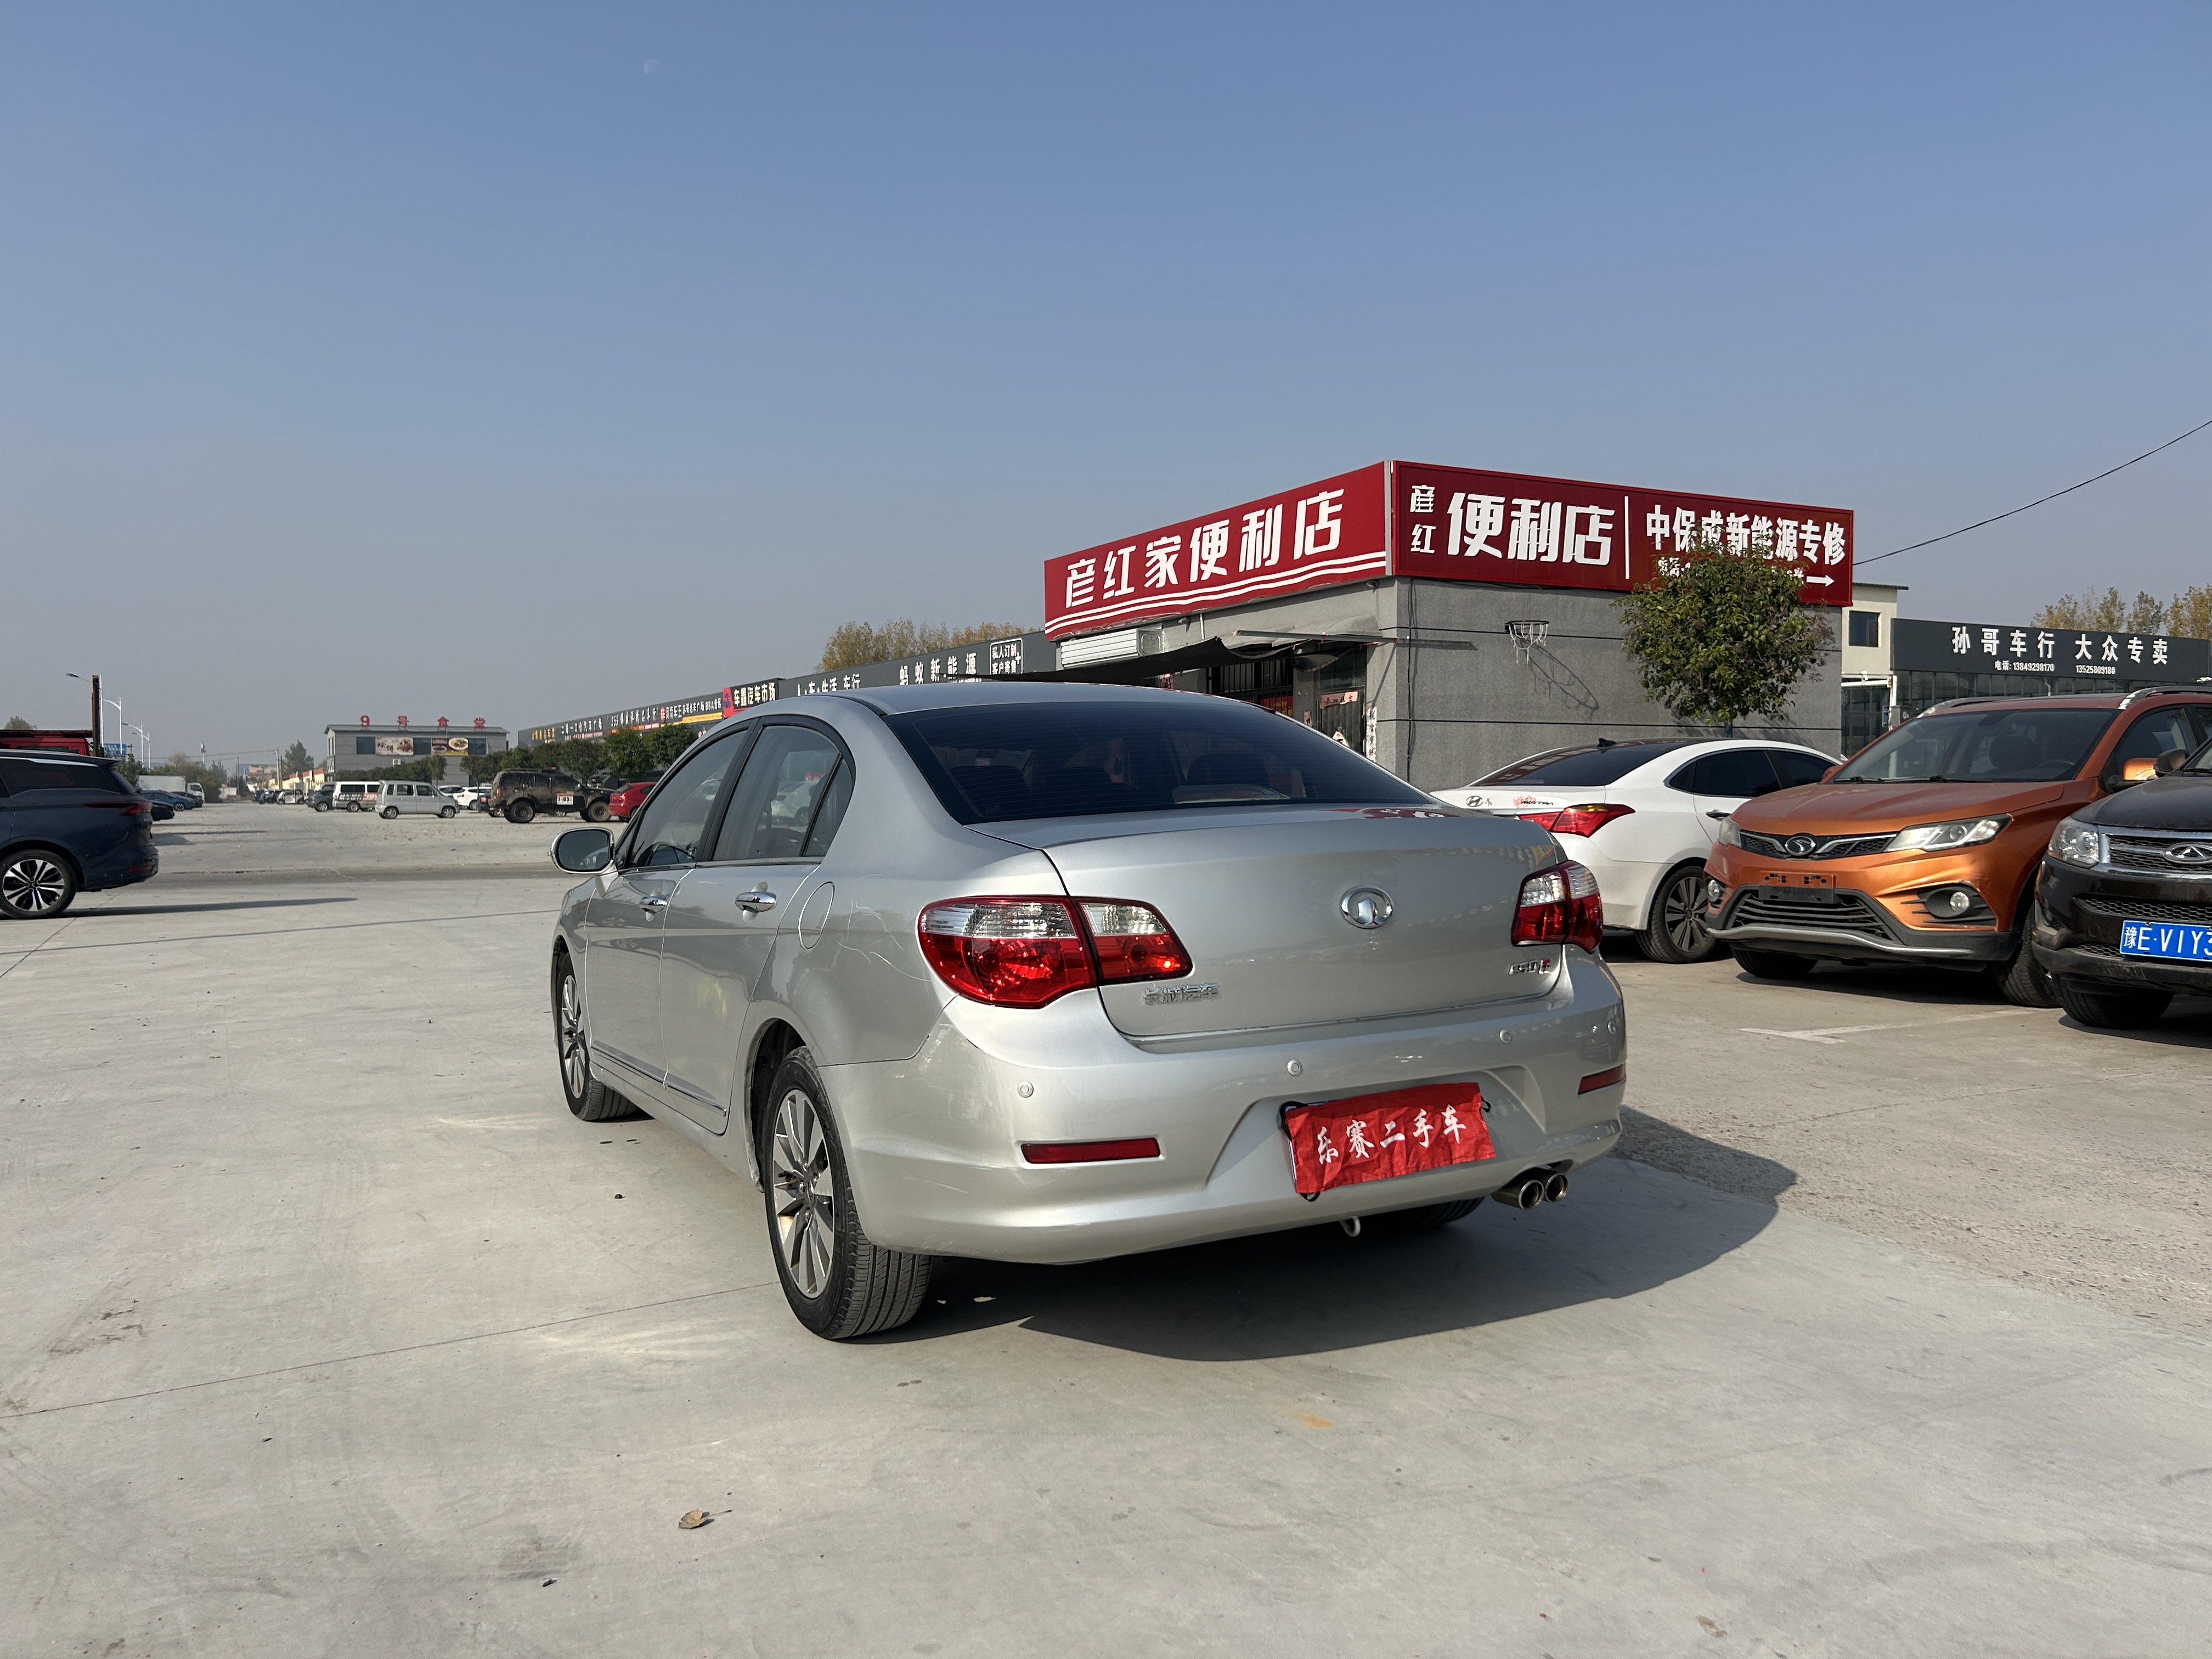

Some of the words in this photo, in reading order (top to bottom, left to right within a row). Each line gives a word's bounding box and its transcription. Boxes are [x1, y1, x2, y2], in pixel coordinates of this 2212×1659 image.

[1065, 489, 1344, 608] 彦红家便利店
[1447, 492, 1615, 566] 便利店
[1951, 626, 2055, 658] 孙哥车行
[2075, 633, 2168, 665] 大众专卖
[900, 652, 977, 686] 蚂蚁新能源
[2075, 664, 2115, 675] 13525809180
